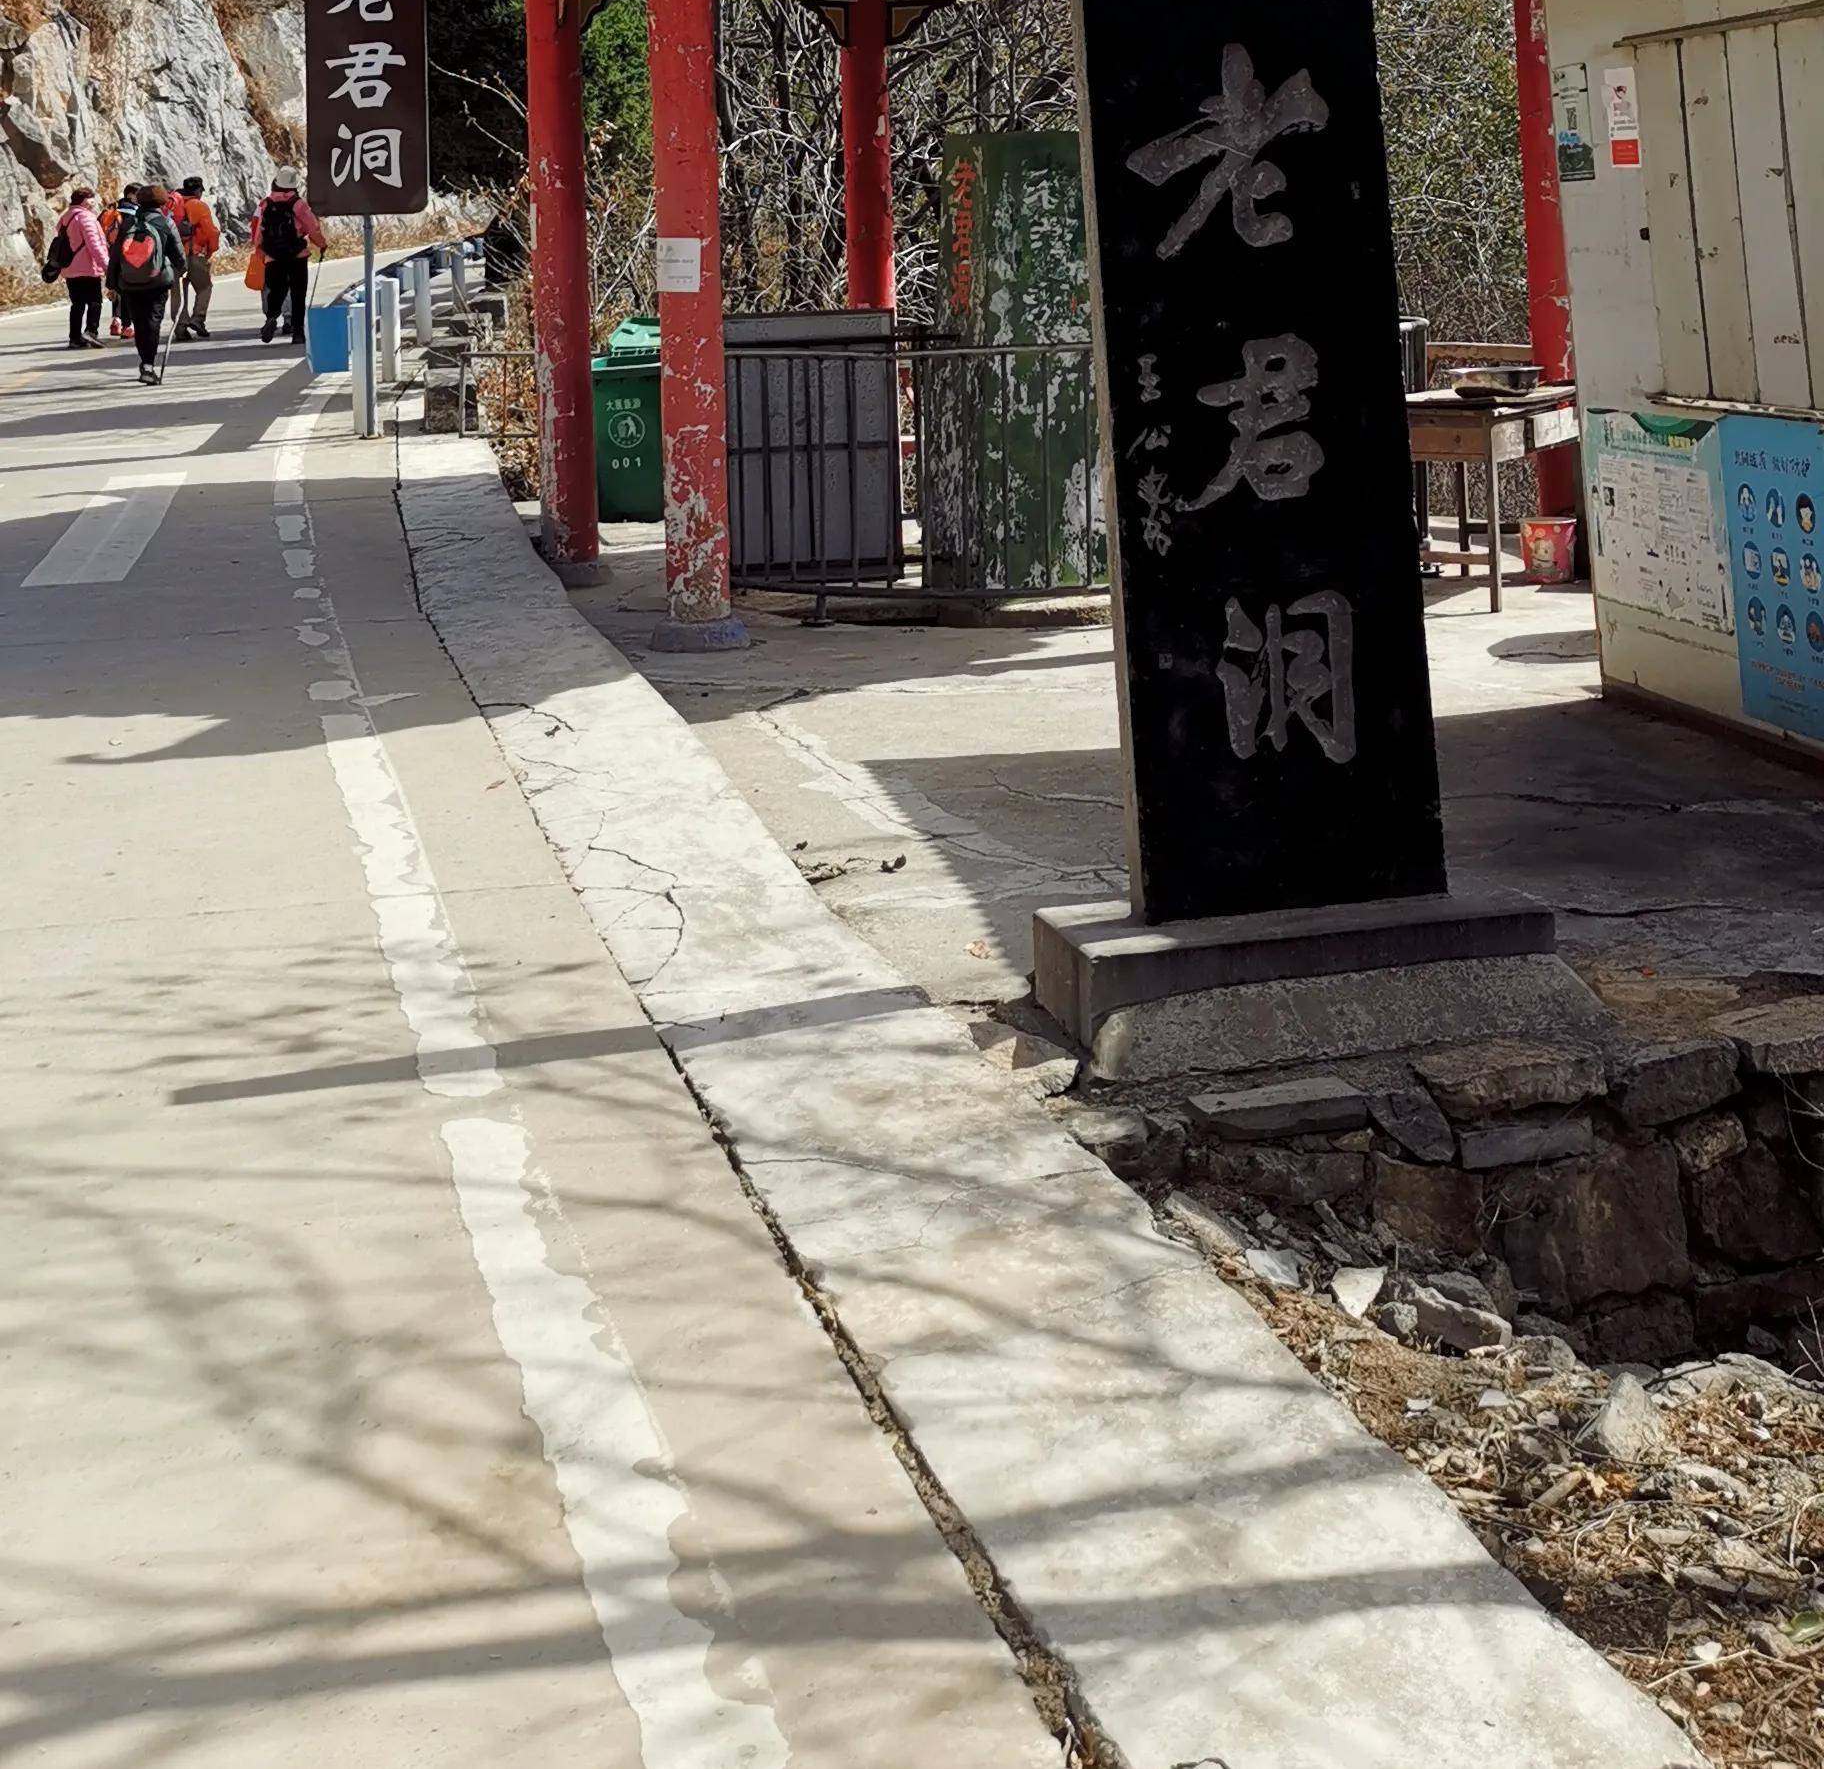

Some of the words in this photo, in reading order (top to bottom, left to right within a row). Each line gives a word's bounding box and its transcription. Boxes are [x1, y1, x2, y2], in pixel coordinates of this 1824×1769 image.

[611, 456, 642, 470] 001
[1125, 42, 1357, 765] 老君洞
